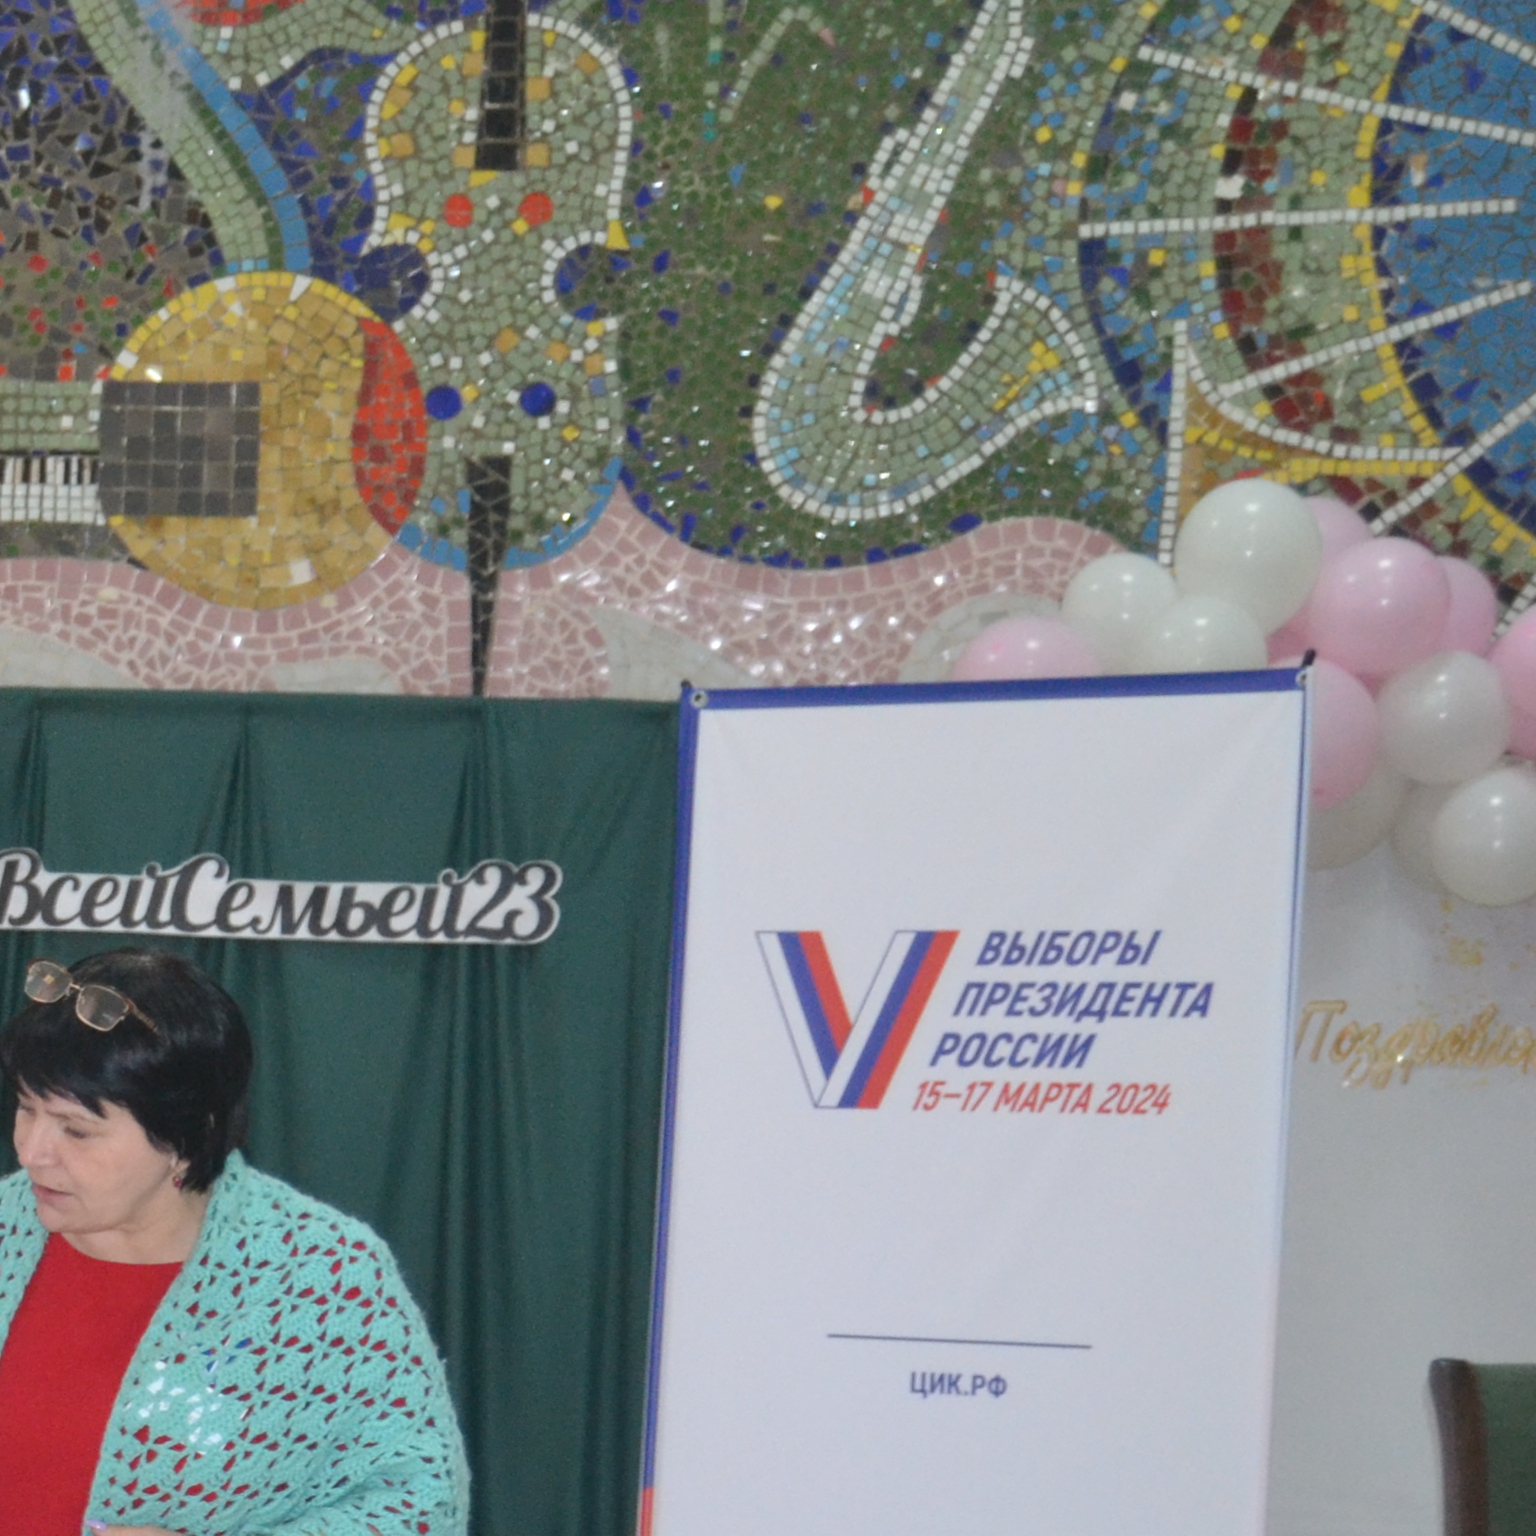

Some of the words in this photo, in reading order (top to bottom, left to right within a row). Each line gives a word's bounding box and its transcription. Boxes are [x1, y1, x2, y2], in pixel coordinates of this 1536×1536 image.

[975, 929, 1164, 968] ВЫБОРЫ
[952, 980, 1215, 1023] ПРЕЗИДЕНТА
[929, 1031, 1098, 1069] РОССИИ
[993, 1082, 1095, 1114] МАРТА
[1096, 1083, 1173, 1115] 2024
[910, 1371, 1008, 1398] ЦИК.РФ
